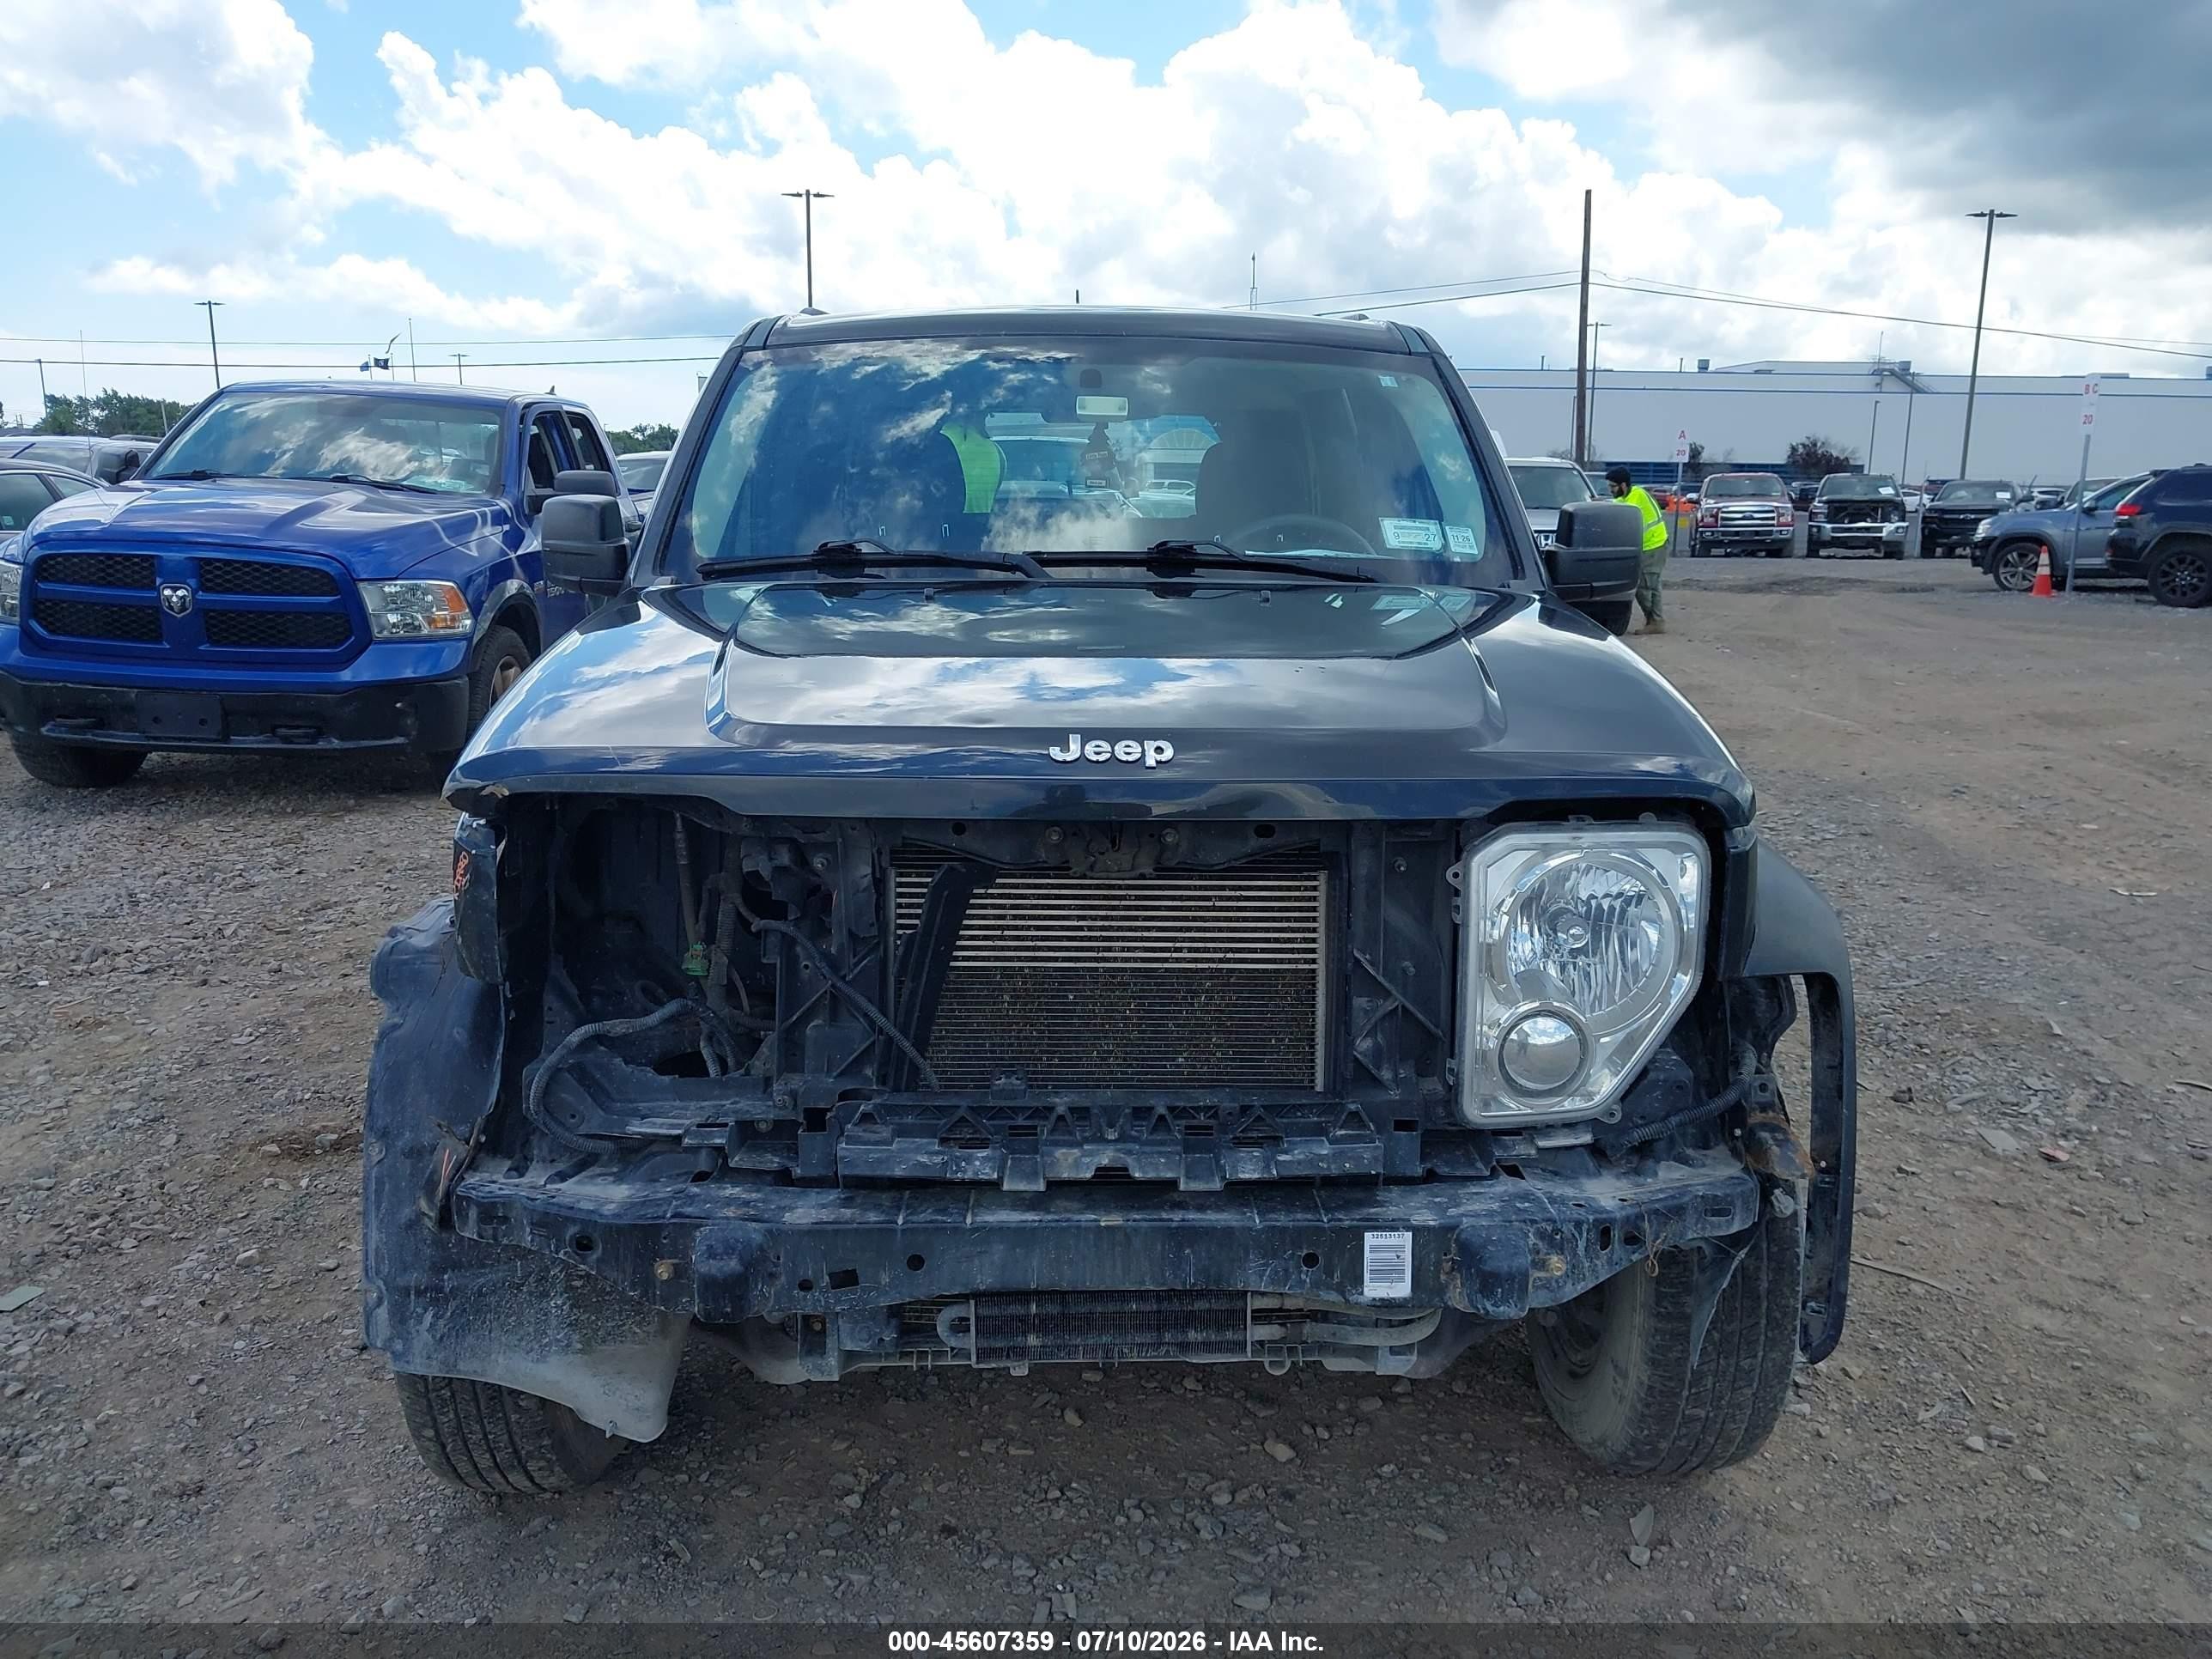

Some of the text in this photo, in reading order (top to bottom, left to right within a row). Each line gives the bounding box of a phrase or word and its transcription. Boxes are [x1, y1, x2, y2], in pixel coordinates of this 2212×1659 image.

[2084, 383, 2099, 395] B C
[2082, 414, 2094, 425] 20
[1678, 430, 1686, 441] A
[1424, 533, 1437, 542] 27
[1048, 733, 1175, 769] Jeep
